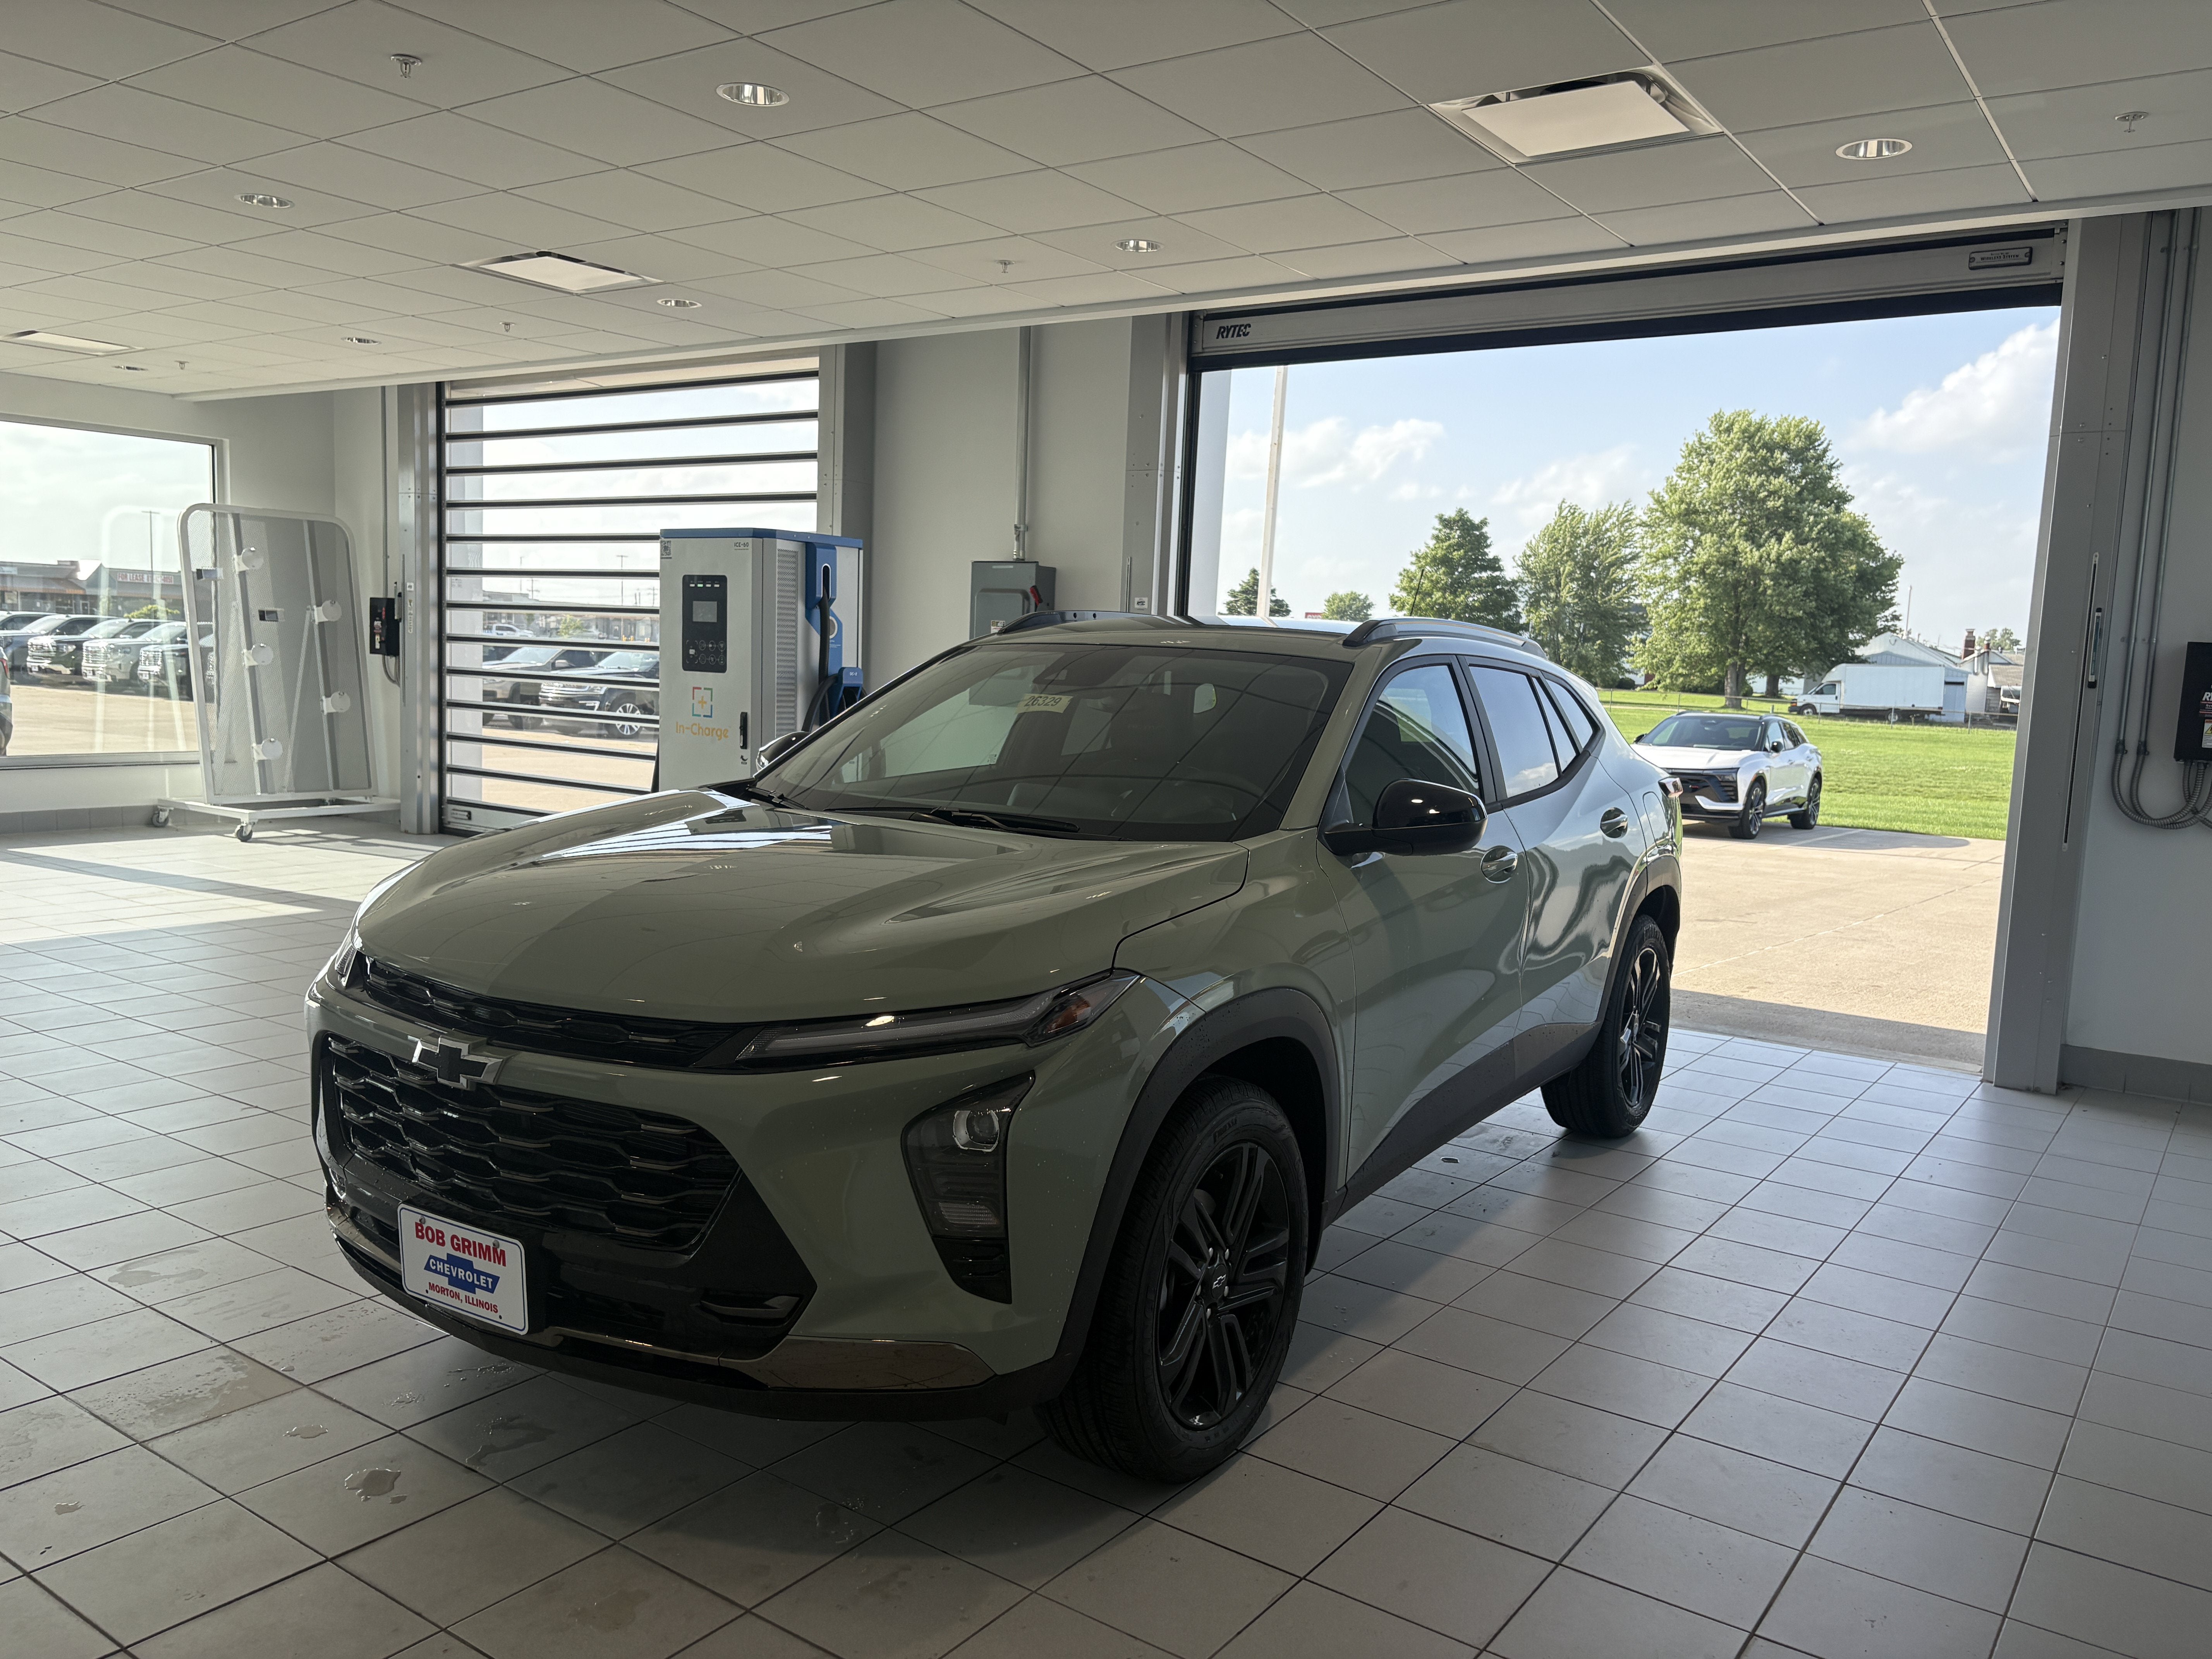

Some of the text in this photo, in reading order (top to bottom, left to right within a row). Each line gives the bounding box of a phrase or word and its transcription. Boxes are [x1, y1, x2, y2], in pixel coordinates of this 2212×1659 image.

[1216, 323, 1251, 339] RYTEC
[1024, 696, 1062, 707] 26329
[675, 722, 729, 741] In-Charge
[415, 1222, 507, 1267] BOB GRIMM
[429, 1259, 493, 1289] CHEVROLET
[428, 1282, 498, 1313] MORTON, ILLINOIS
